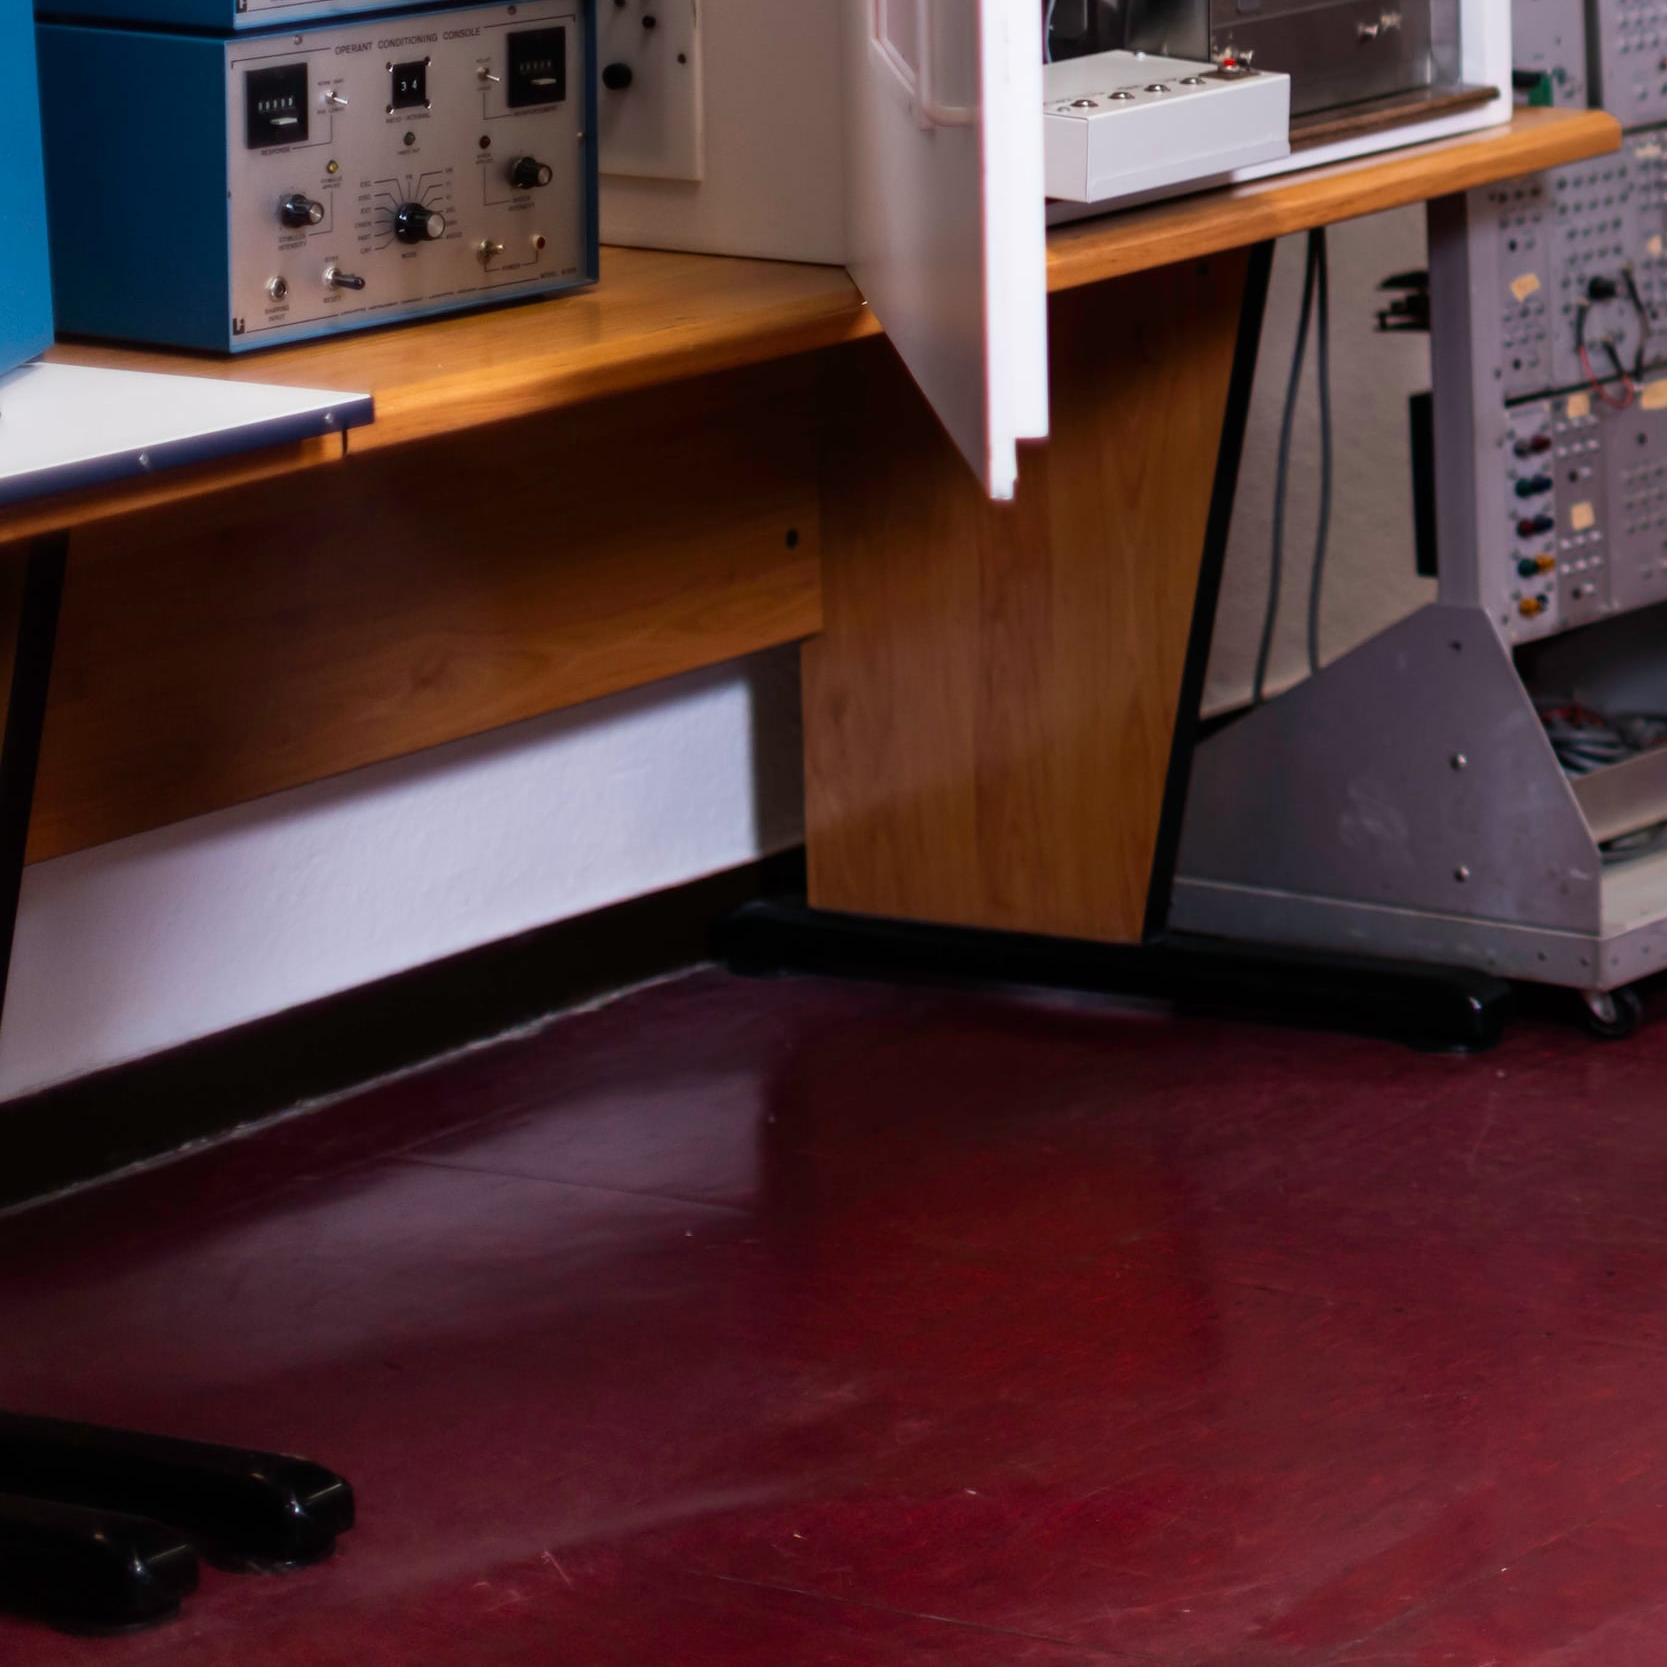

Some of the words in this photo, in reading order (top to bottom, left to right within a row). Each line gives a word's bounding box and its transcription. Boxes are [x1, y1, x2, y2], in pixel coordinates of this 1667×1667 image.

[334, 42, 372, 56] OPERANT
[377, 32, 437, 50] CONDITIONING
[442, 27, 480, 41] CONSOLE
